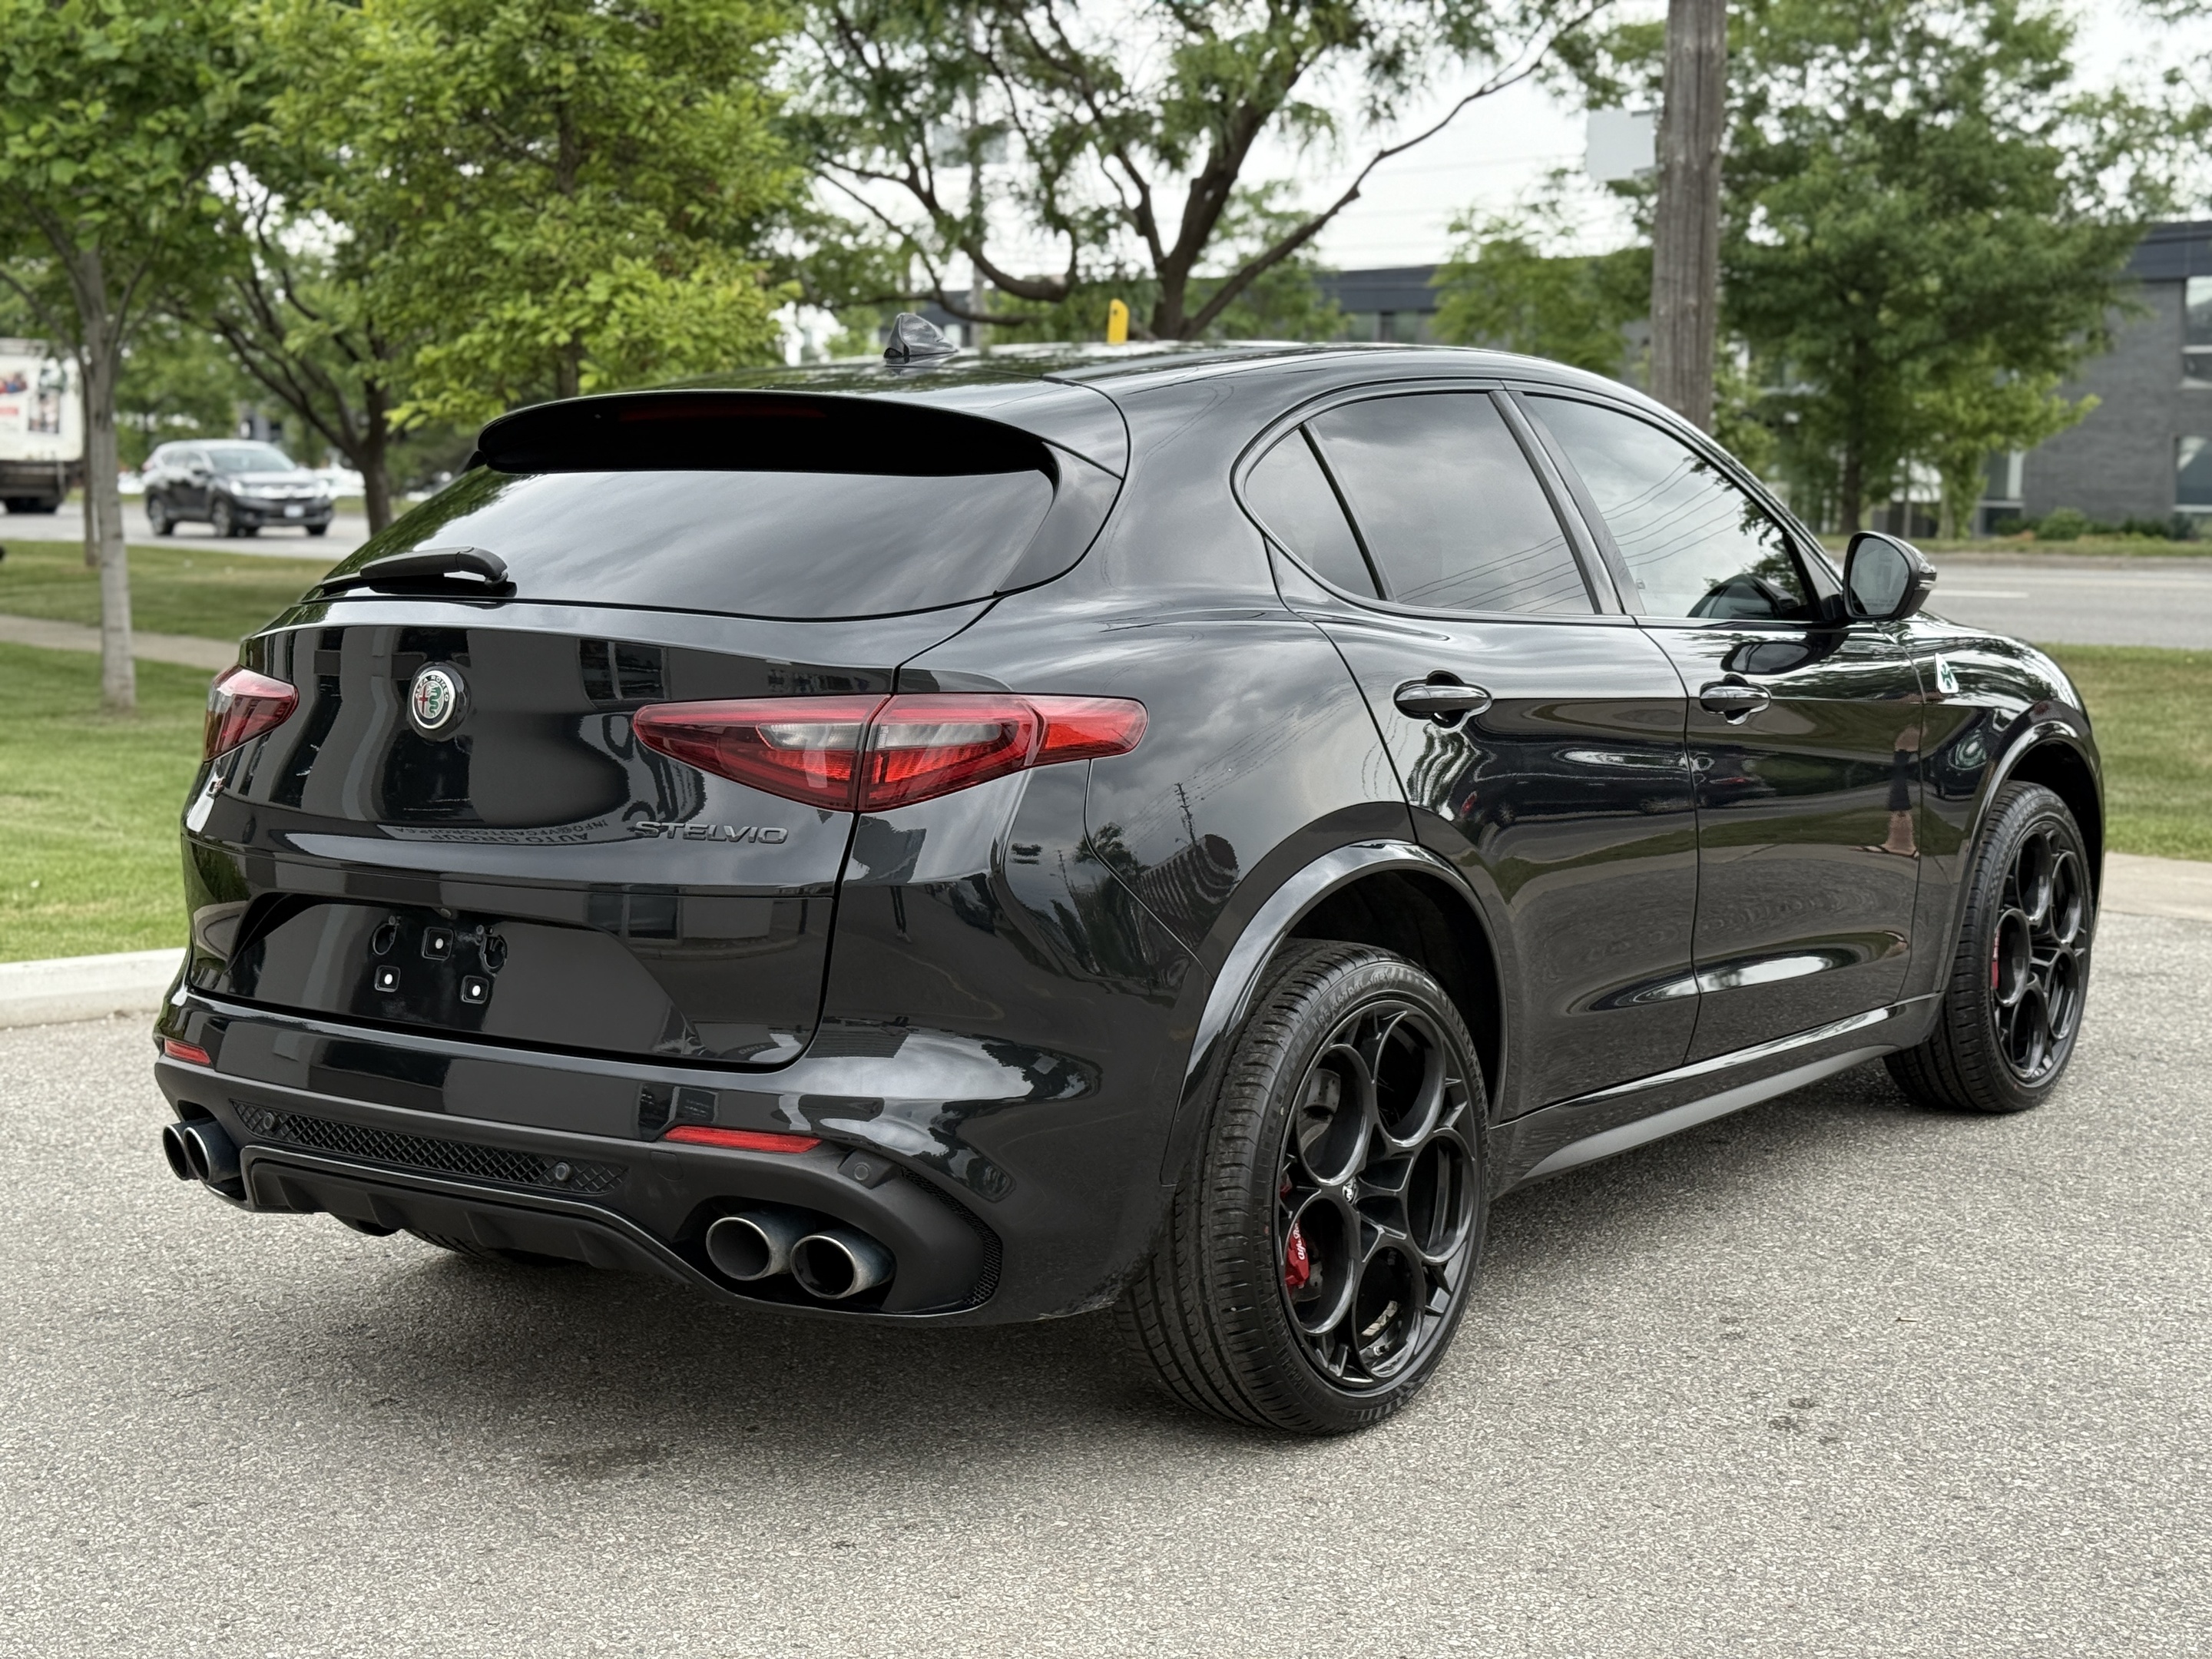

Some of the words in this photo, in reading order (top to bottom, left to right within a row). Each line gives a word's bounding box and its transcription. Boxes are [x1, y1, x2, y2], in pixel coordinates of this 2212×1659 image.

[634, 820, 789, 845] STELVIO
[431, 834, 519, 843] GROUP
[525, 833, 588, 843] AUTO
